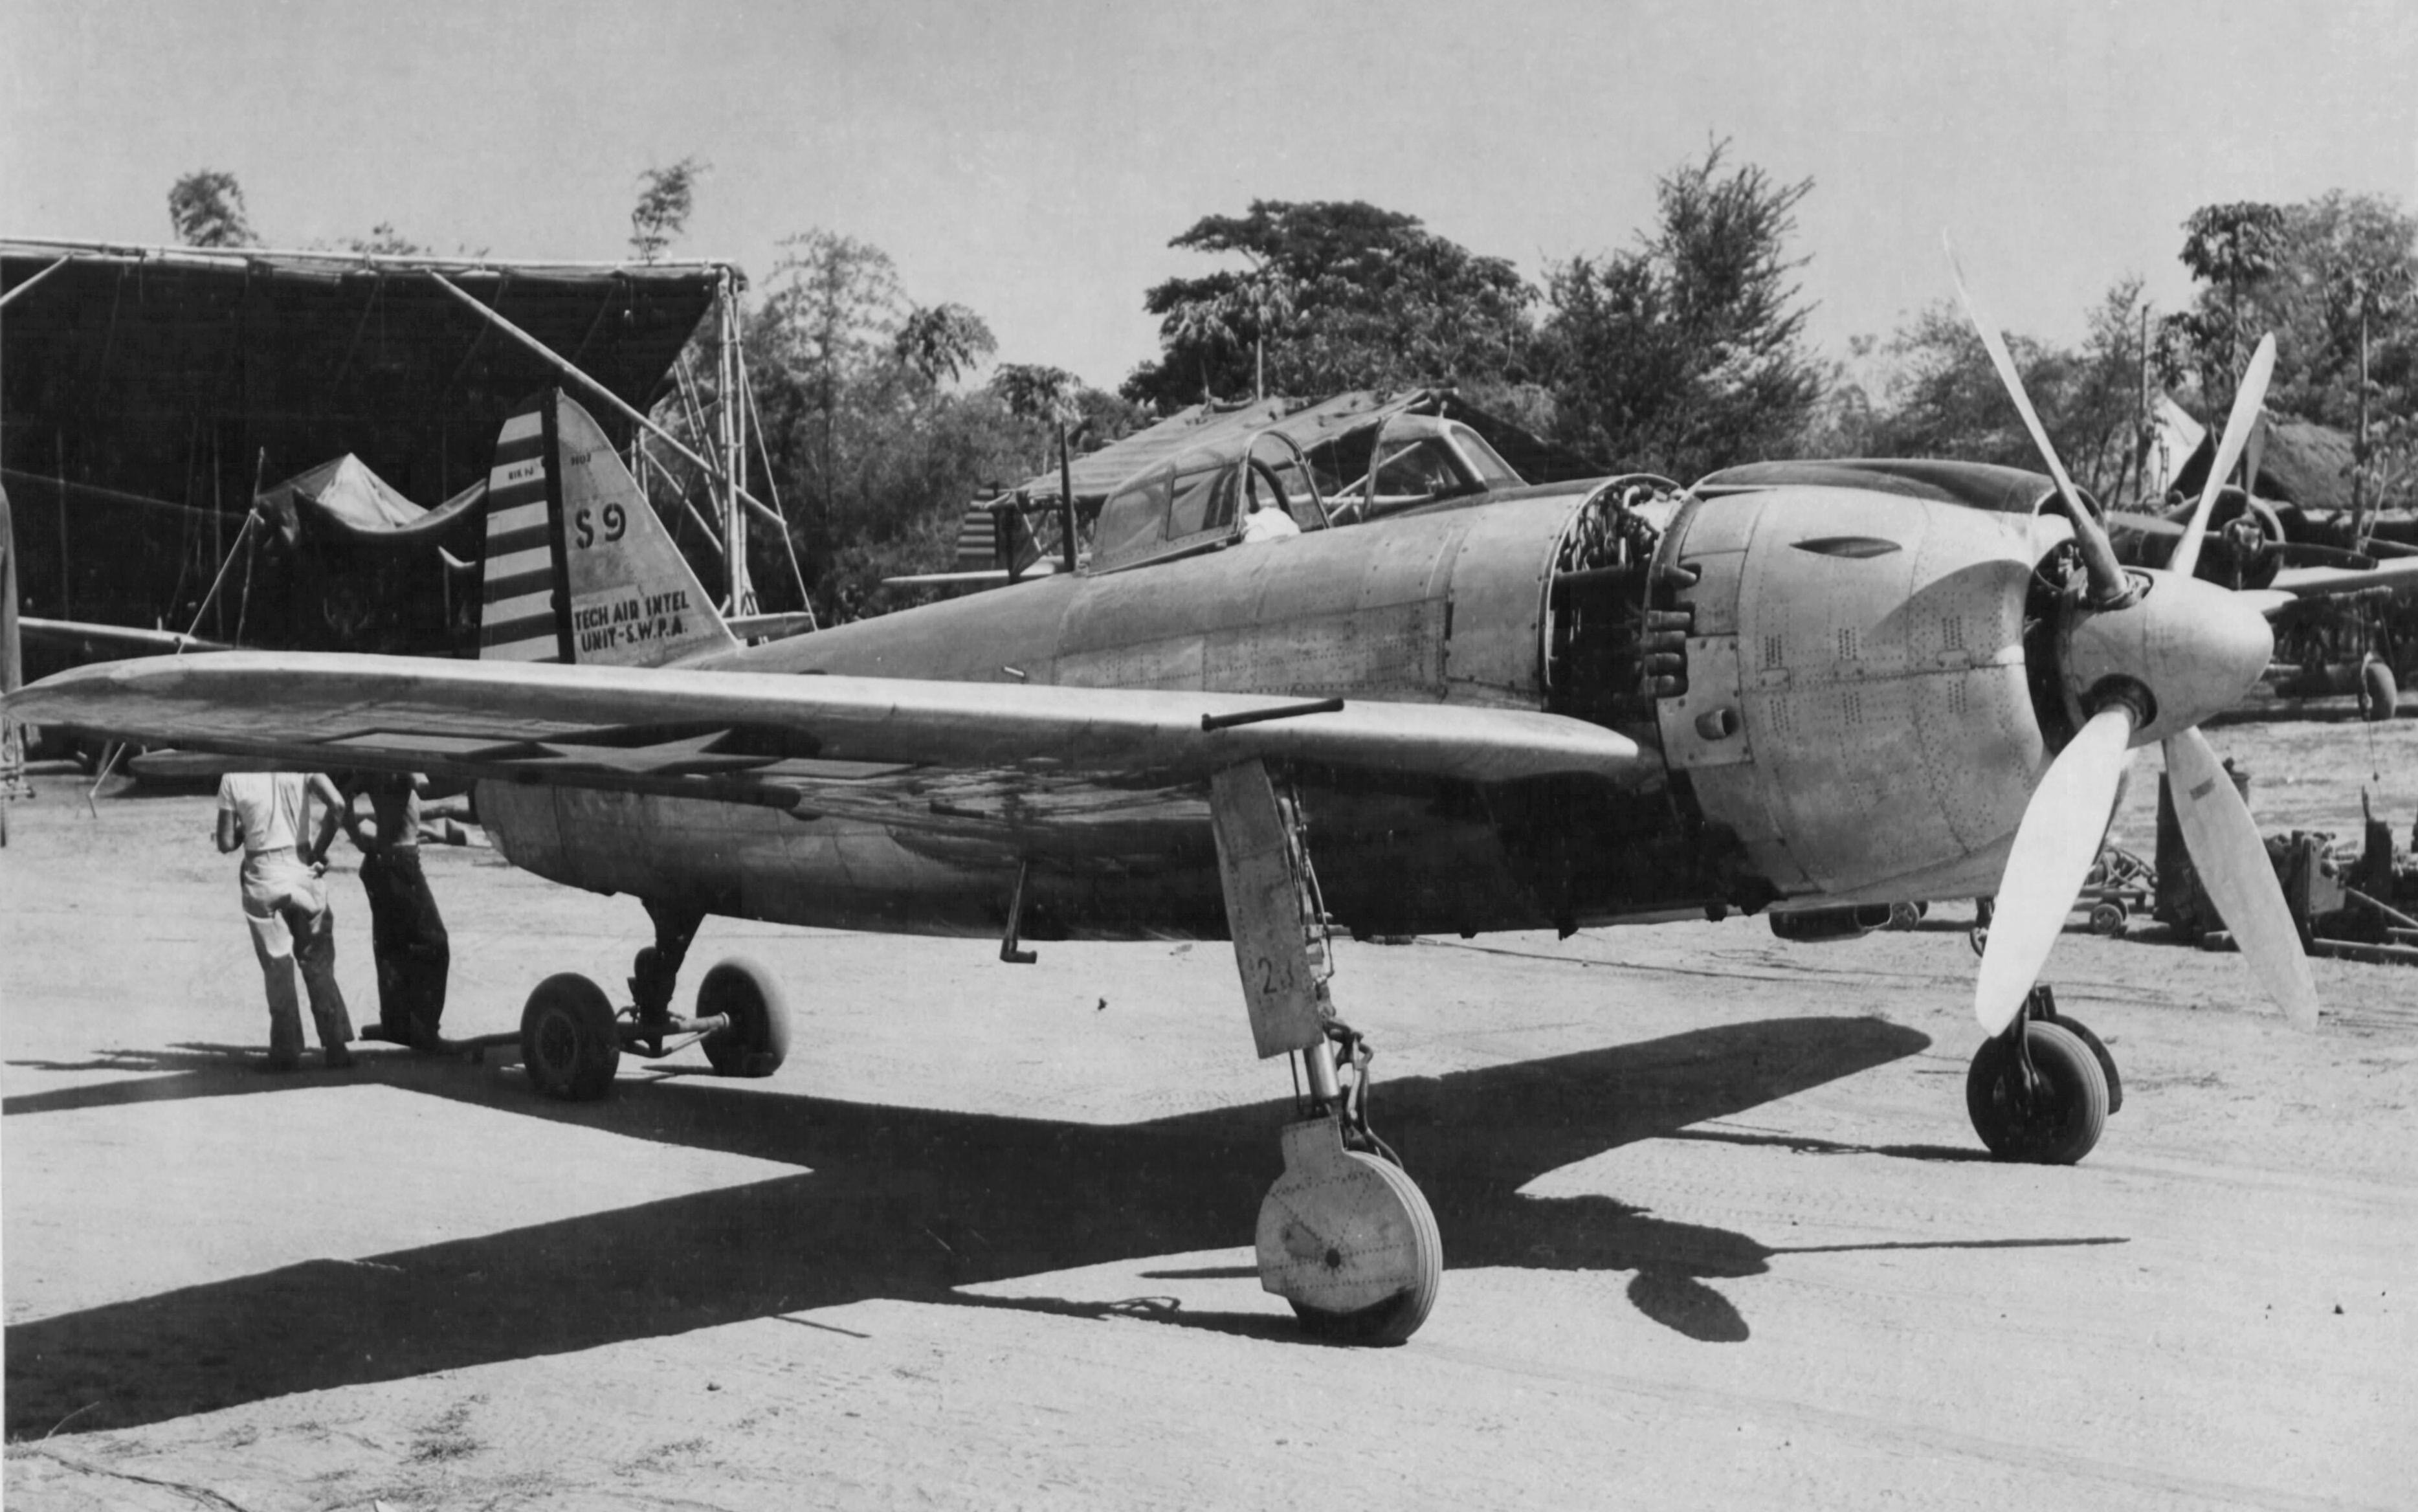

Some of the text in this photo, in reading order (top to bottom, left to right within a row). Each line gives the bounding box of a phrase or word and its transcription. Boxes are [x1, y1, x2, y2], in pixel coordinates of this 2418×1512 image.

[574, 590, 689, 632] TECH AIR INTEL
